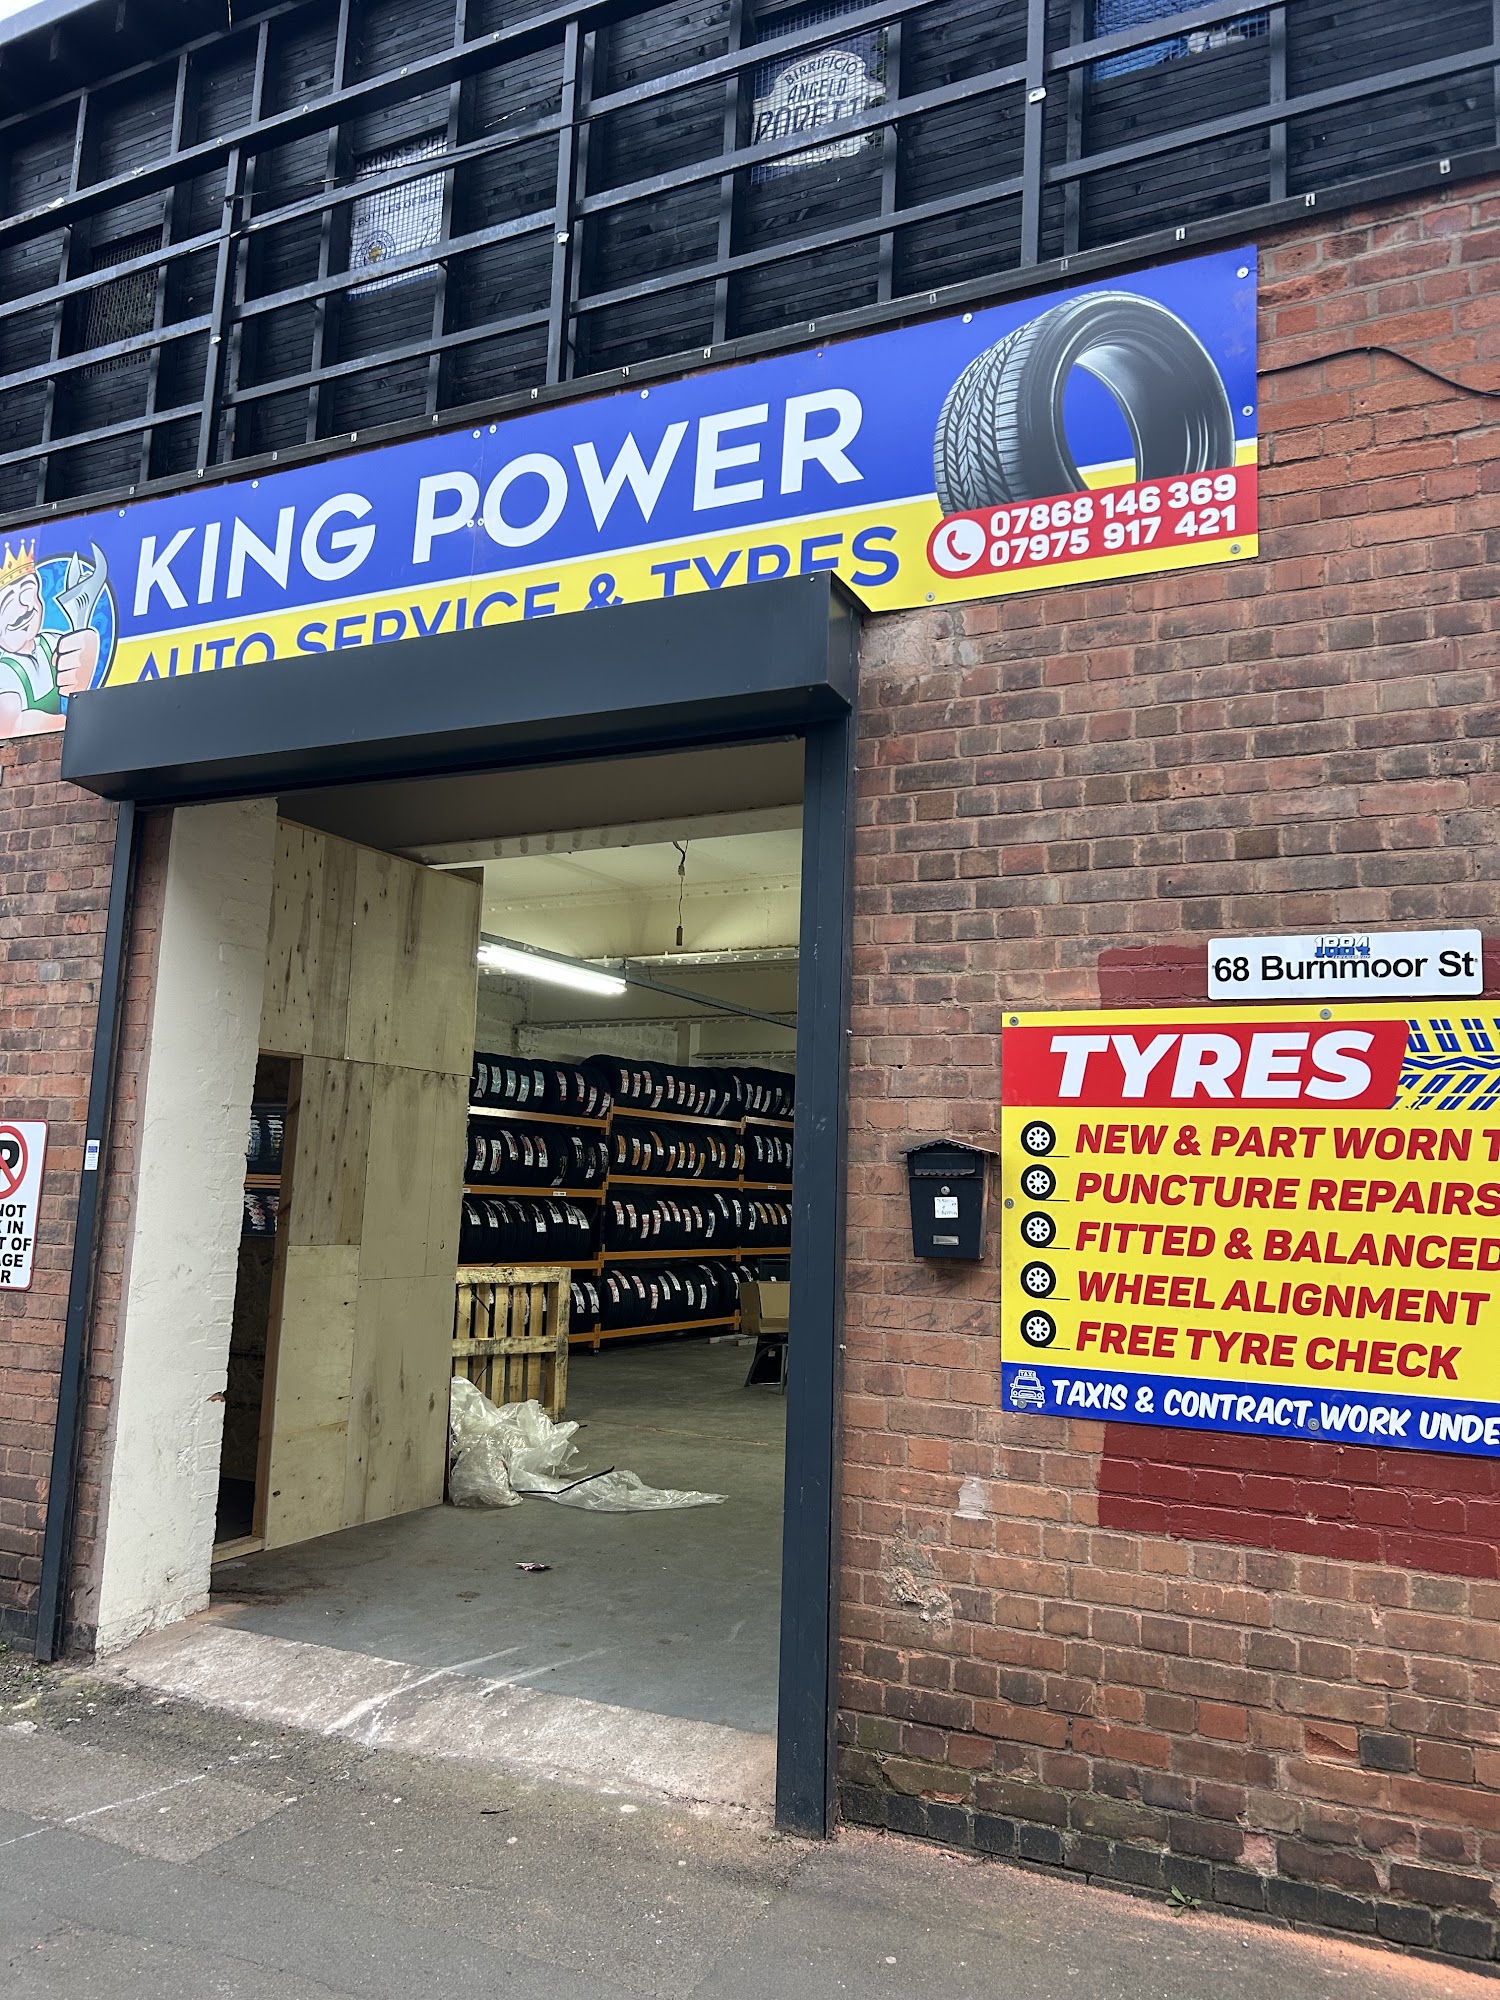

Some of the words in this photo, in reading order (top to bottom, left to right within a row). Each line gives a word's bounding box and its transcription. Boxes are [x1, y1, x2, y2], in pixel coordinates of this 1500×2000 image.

[784, 56, 859, 86] BIRRIFICIO
[787, 77, 848, 104] ANGELO
[134, 494, 376, 617] KING
[413, 388, 864, 565] POWER
[990, 496, 1094, 538] 07868
[1099, 486, 1161, 519] 146
[1168, 473, 1237, 510] 369
[989, 527, 1090, 567] 07975
[1104, 516, 1162, 550] 917
[1174, 504, 1236, 538] 421
[583, 573, 624, 611] &
[651, 525, 900, 598] TYRES
[1214, 956, 1250, 982] 68
[1261, 954, 1429, 982] Burnmoor
[1438, 950, 1475, 978] St
[1314, 935, 1371, 958] 1884
[1049, 1030, 1374, 1100] TYRES
[1075, 1124, 1169, 1155] NEW
[1173, 1124, 1201, 1156] &
[1211, 1125, 1326, 1158] PART
[1333, 1127, 1473, 1162] WORN
[1075, 1172, 1301, 1210] PUNCTURE
[1307, 1178, 1500, 1217] REPAIRS
[7, 1220, 24, 1235] IN
[11, 1236, 32, 1252] OF
[1075, 1221, 1216, 1258] FITTED
[1224, 1227, 1252, 1260] &
[1263, 1229, 1500, 1272] BALANCED
[0, 1252, 24, 1268] GE
[1078, 1270, 1215, 1310] WHEEL
[1221, 1279, 1491, 1326] ALIGNMENT
[1076, 1320, 1179, 1359] FREE
[1185, 1328, 1298, 1368] TYRE
[1305, 1337, 1462, 1381] CHECK
[1051, 1379, 1128, 1411] TAXIS
[1134, 1386, 1154, 1413] &
[1164, 1388, 1314, 1428] CONTRACT
[1320, 1402, 1412, 1437] WORK
[1418, 1411, 1500, 1446] UNDE
